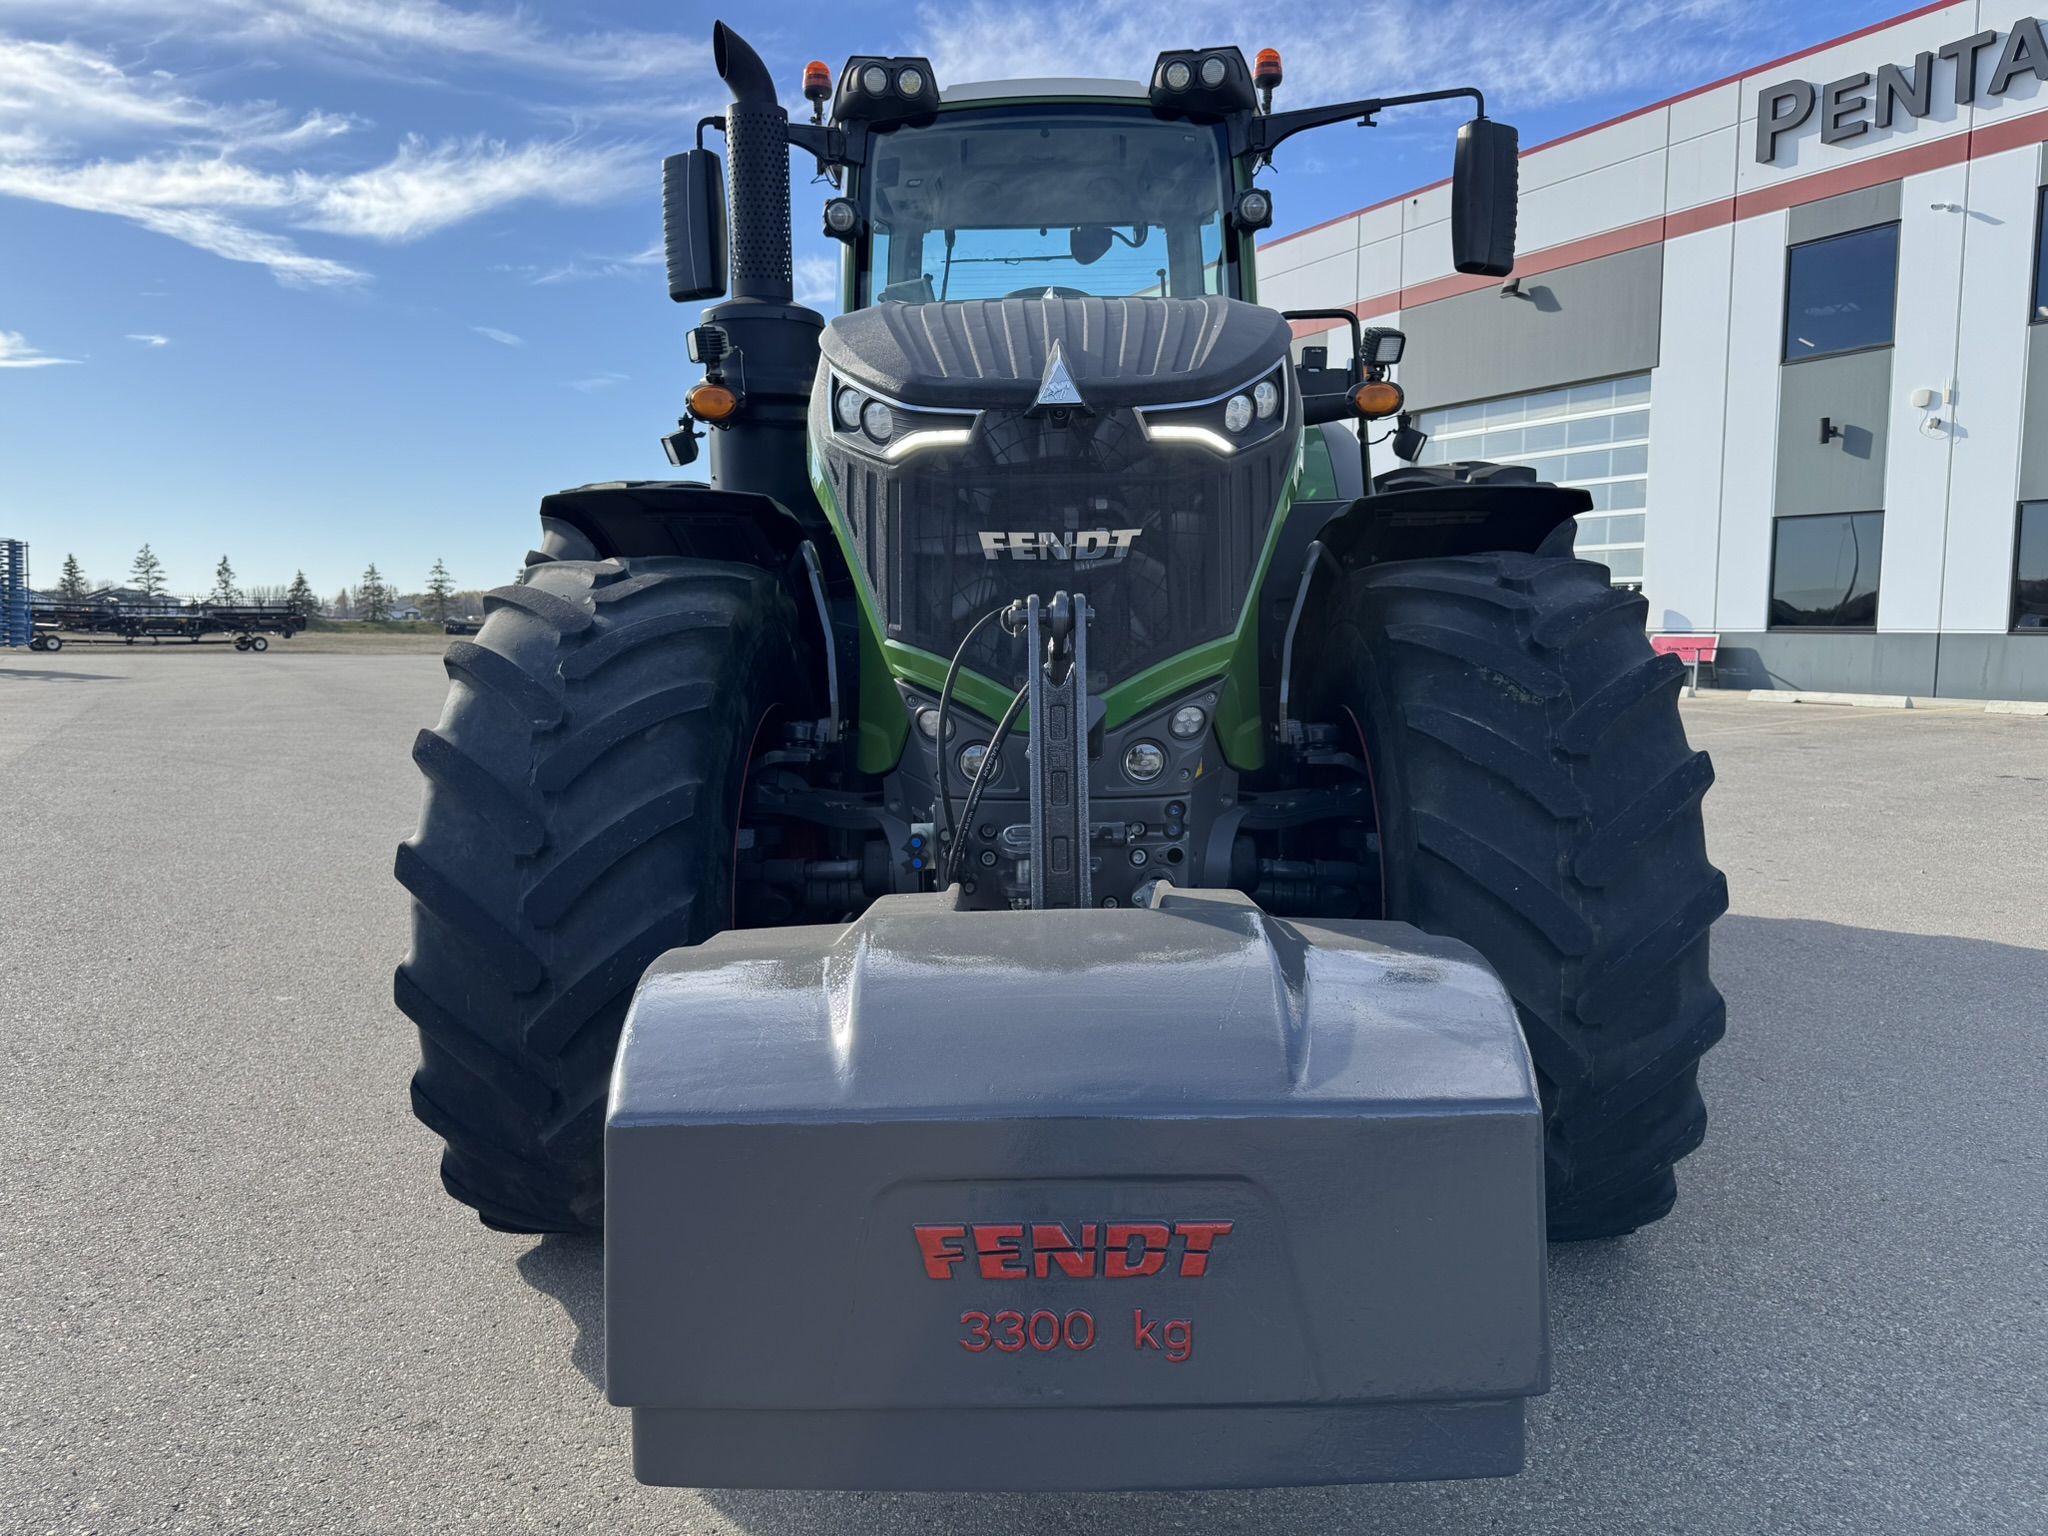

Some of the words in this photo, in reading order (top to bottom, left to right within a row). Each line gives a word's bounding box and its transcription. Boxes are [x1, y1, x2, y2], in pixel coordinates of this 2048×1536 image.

[1755, 16, 2048, 164] PENTA
[978, 528, 1143, 561] FENDT
[912, 1219, 1235, 1280] FENDT
[959, 1308, 1096, 1351] 3300
[1133, 1307, 1194, 1363] kg
